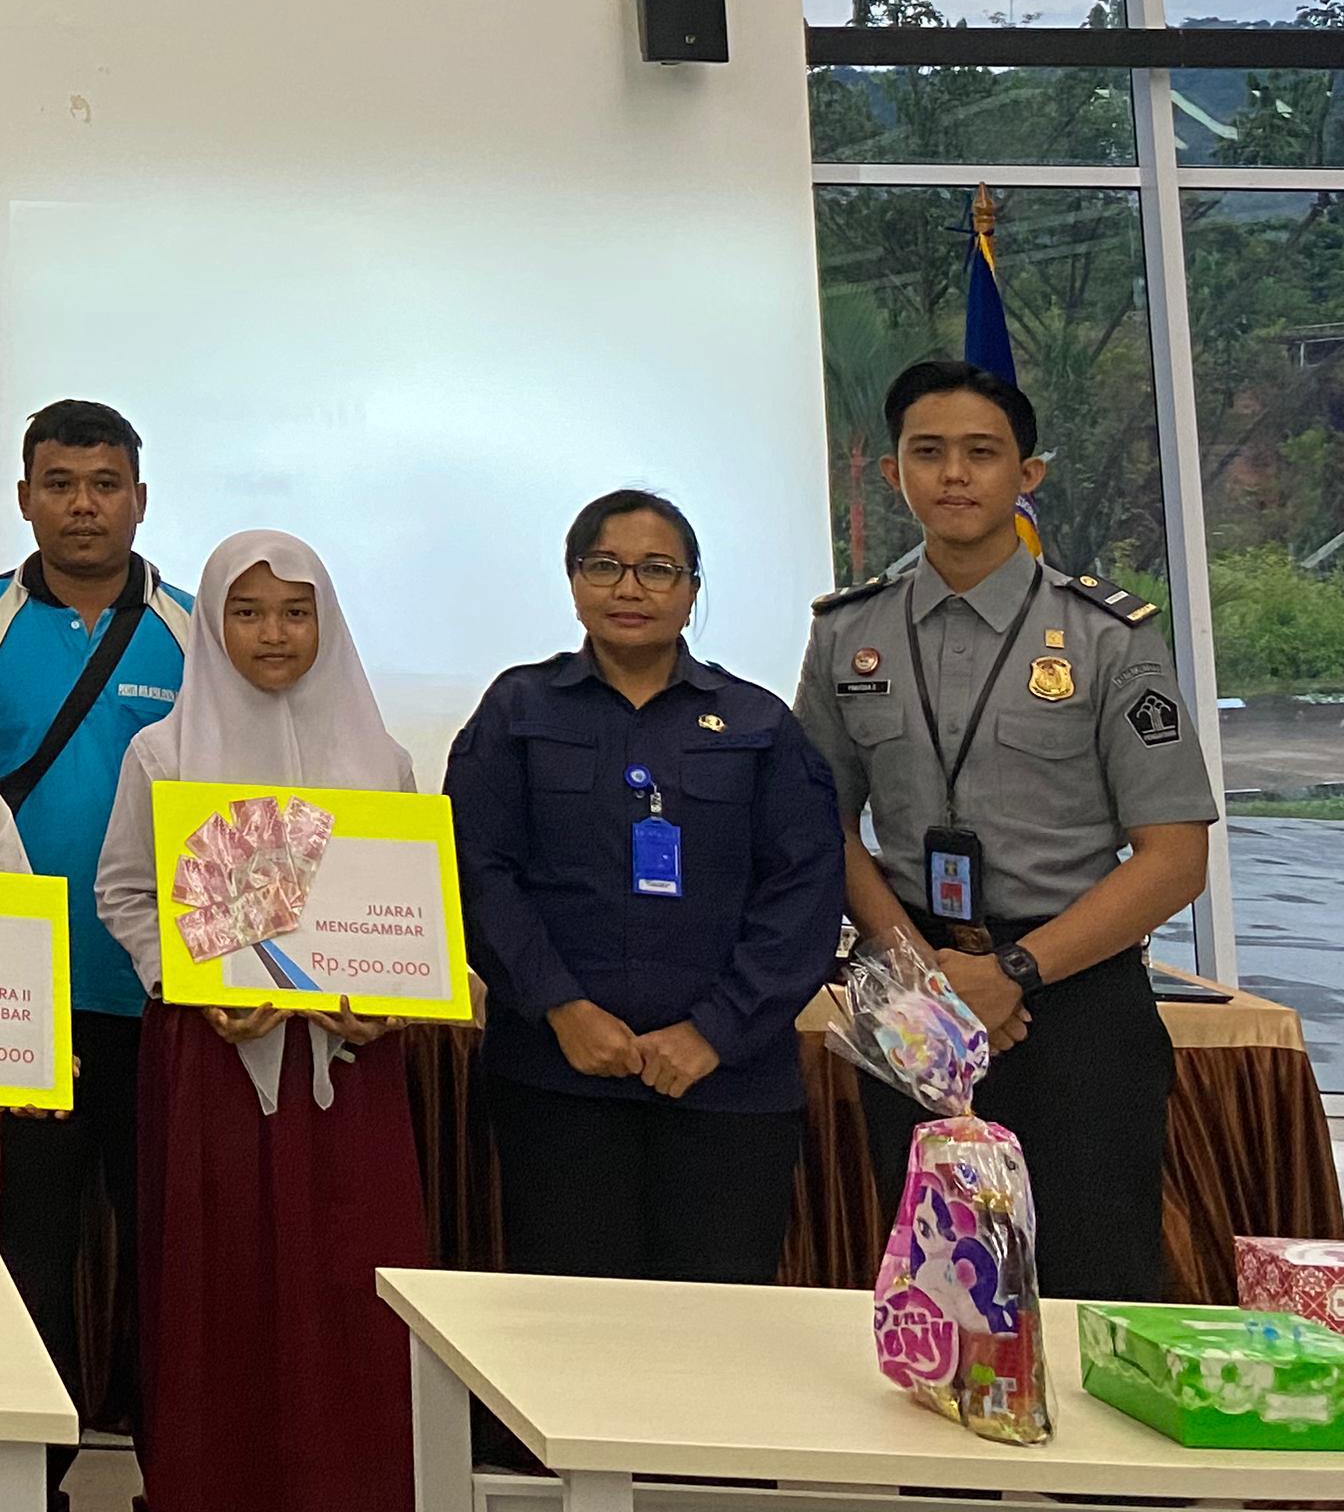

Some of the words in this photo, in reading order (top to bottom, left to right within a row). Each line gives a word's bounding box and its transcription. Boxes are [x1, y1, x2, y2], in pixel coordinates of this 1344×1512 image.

[365, 903, 416, 919] JUARA
[418, 905, 423, 919] I
[315, 919, 425, 938] MENGGAMBAR
[311, 950, 432, 978] Rp.500.000
[22, 987, 32, 1002] II
